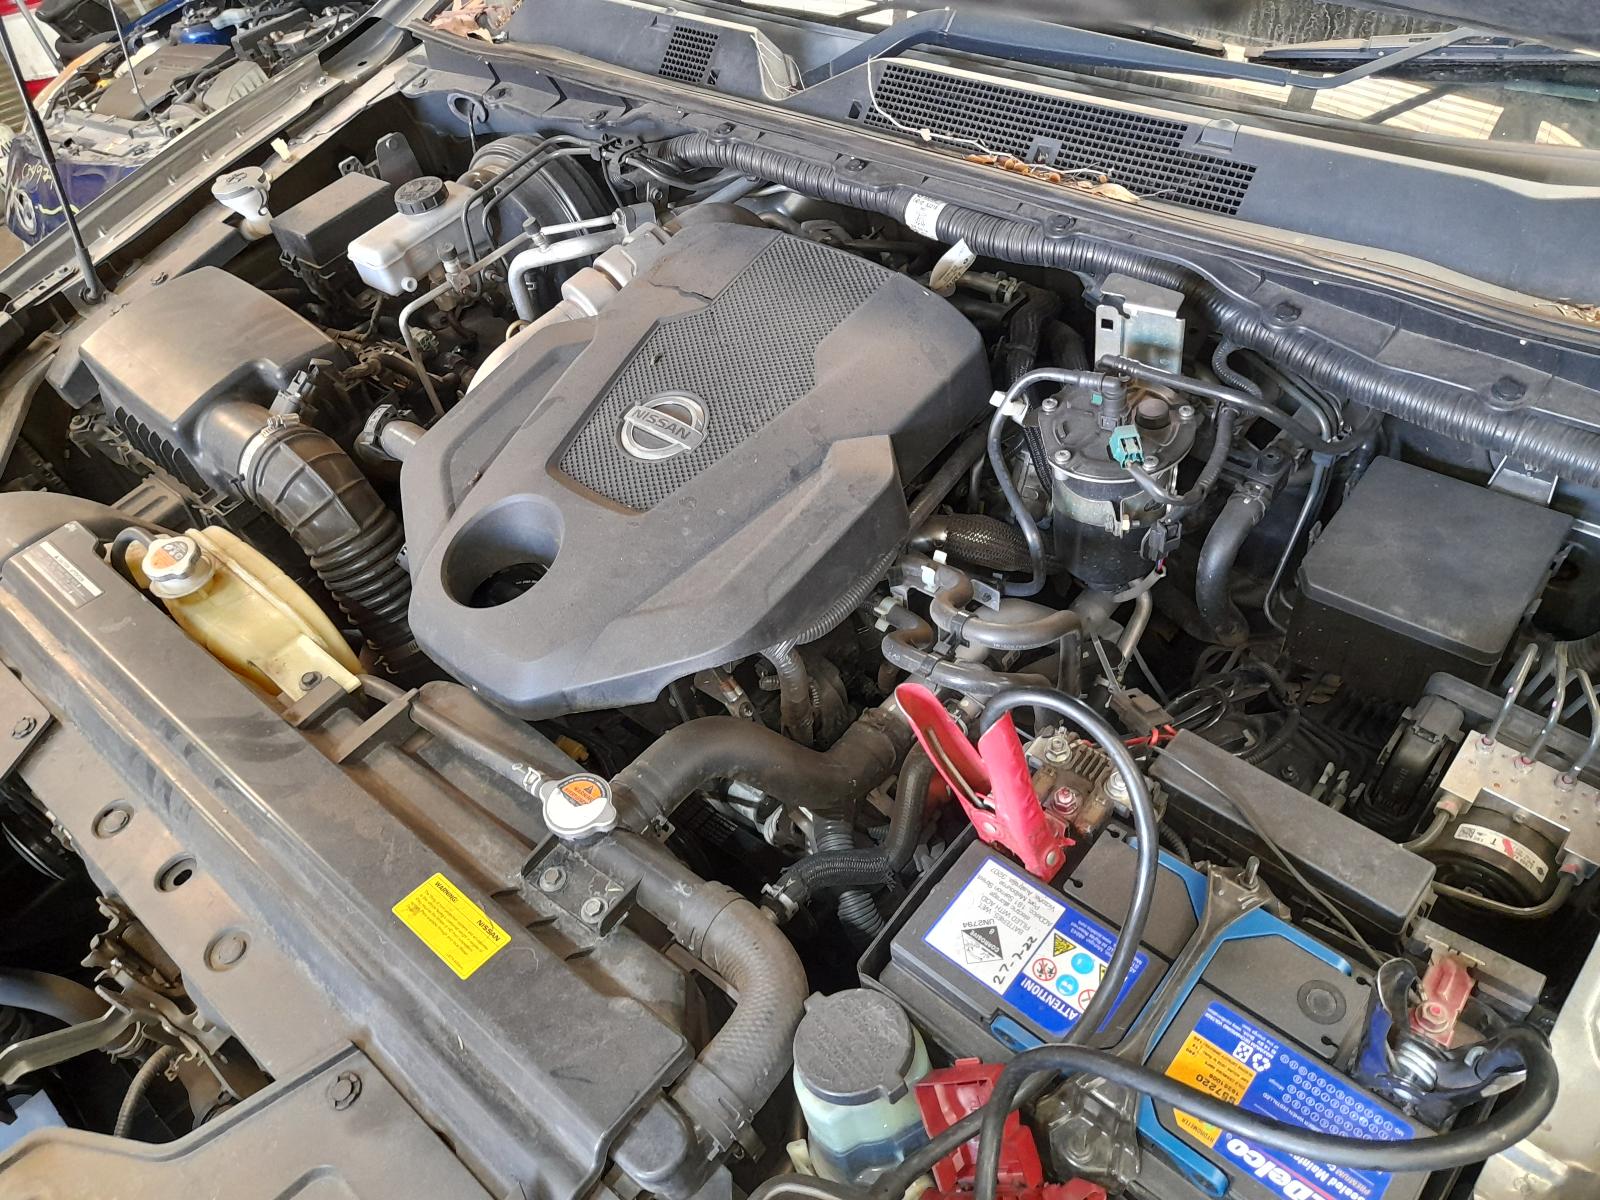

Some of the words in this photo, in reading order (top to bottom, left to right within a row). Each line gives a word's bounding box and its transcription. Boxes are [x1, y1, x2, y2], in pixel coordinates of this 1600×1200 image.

[632, 406, 691, 440] NISSAN
[990, 866, 1007, 879] 3207
[994, 904, 1011, 917] WITH
[1010, 914, 1031, 930] FILLED
[476, 918, 501, 942] NISSAN
[962, 918, 994, 928] UN2794
[968, 928, 1000, 953] CORROSIVE
[1020, 976, 1078, 1022] ATTENTION!
[1261, 1091, 1289, 1112] INSTALLED
[1181, 1117, 1214, 1142] HYDROMETER
[1334, 1167, 1371, 1196] PREMIUM
